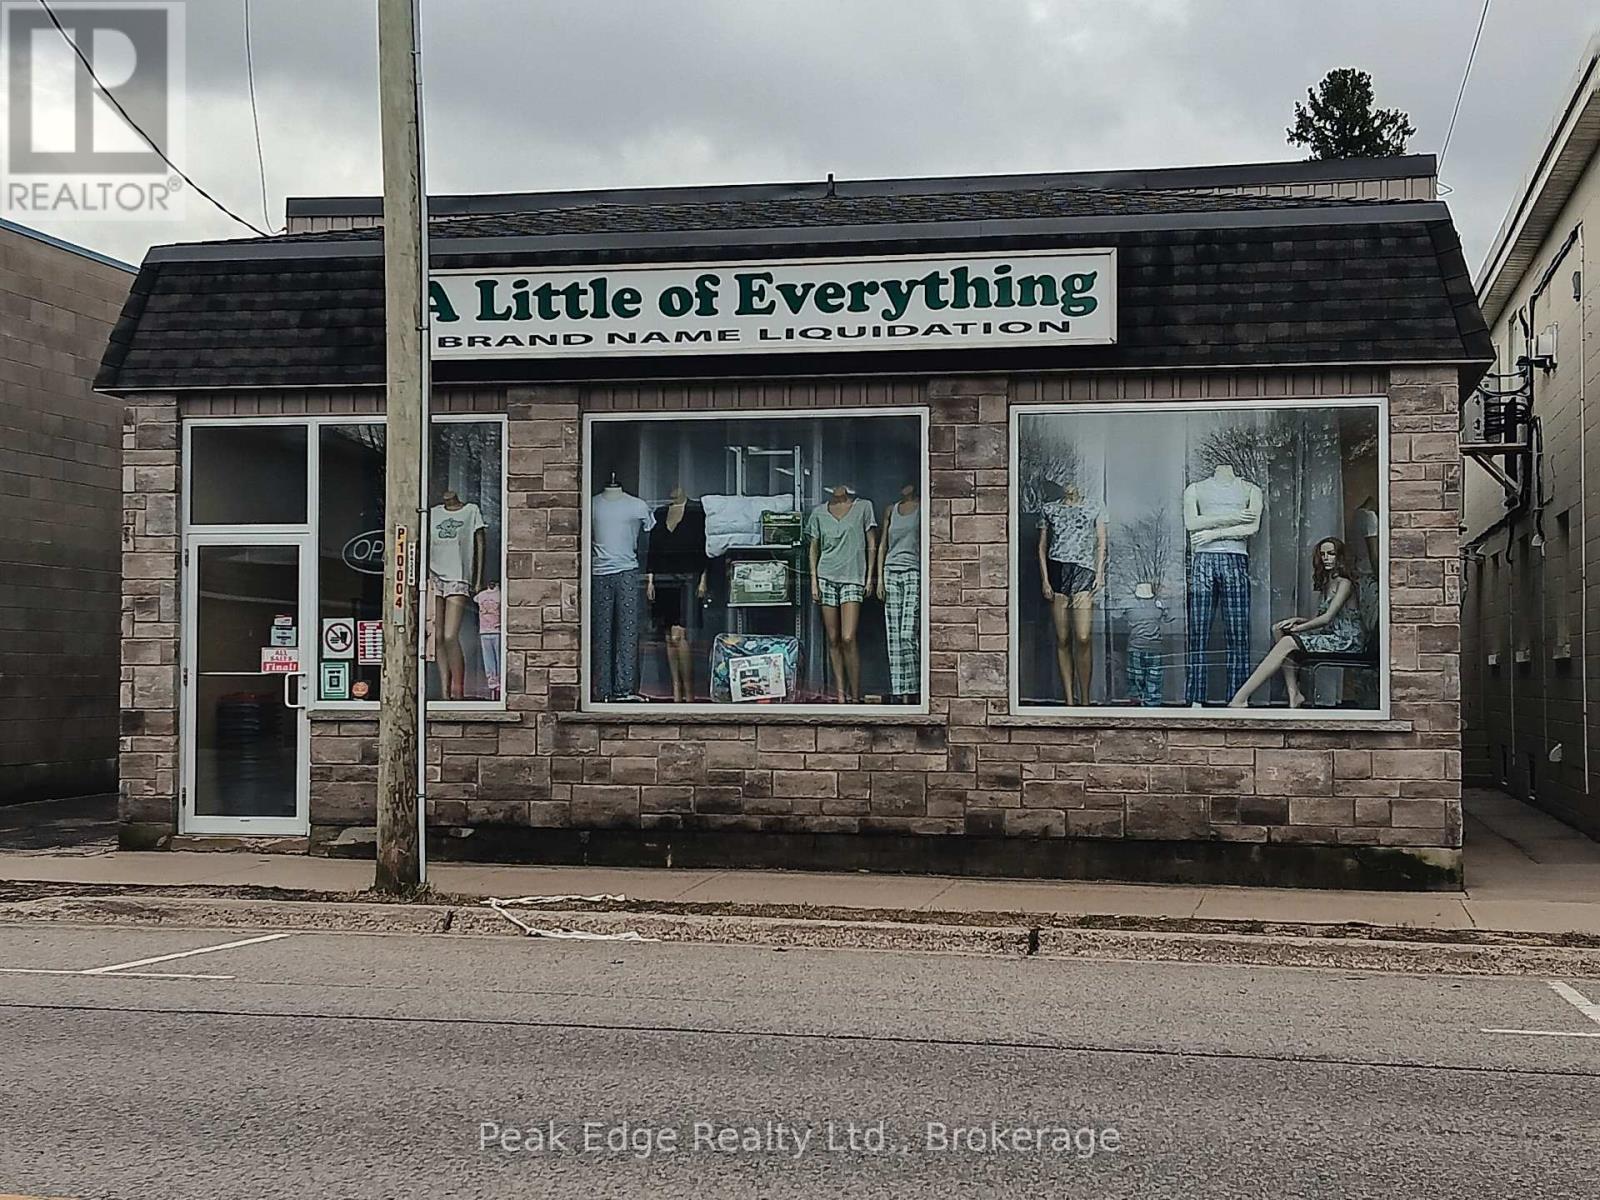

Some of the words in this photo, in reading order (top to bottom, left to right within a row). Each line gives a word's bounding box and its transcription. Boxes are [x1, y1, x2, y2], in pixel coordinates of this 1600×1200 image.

[429, 280, 460, 322] A
[475, 277, 642, 321] Little
[659, 274, 720, 317] of
[734, 265, 1098, 321] Everything
[438, 333, 593, 348] BRAND
[607, 329, 740, 345] NAME
[759, 321, 1070, 341] LIQUIDATION
